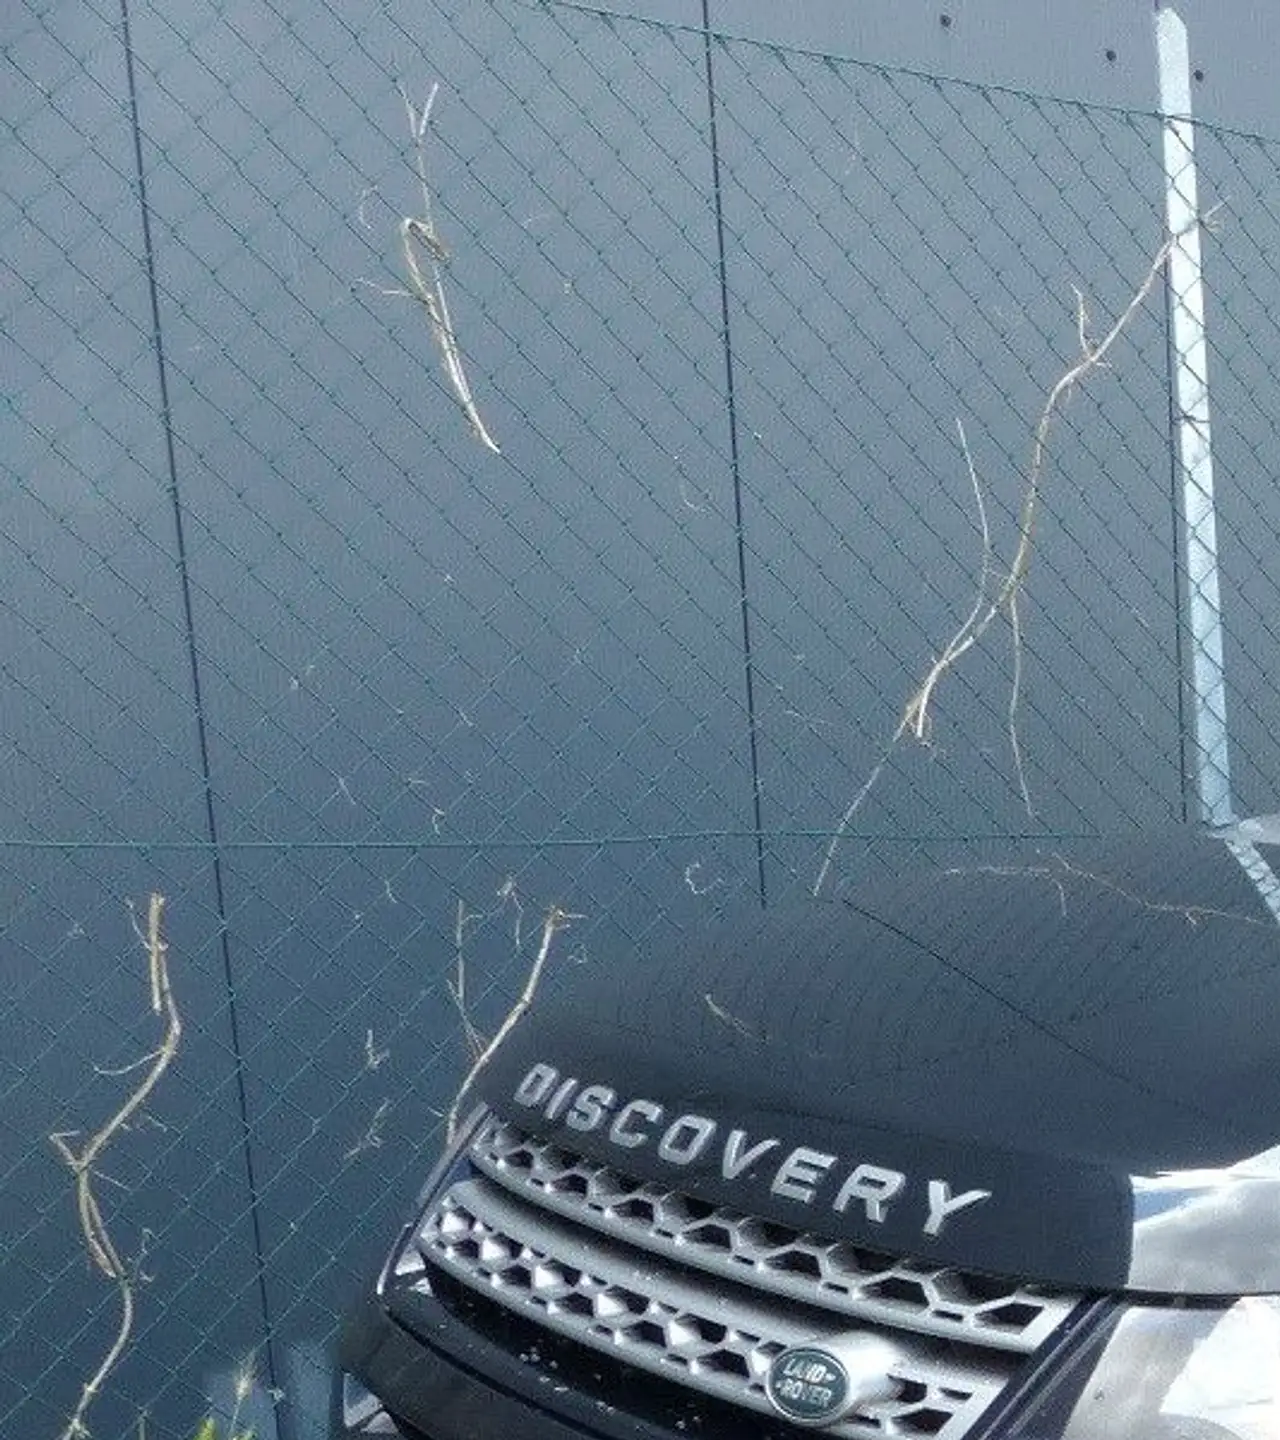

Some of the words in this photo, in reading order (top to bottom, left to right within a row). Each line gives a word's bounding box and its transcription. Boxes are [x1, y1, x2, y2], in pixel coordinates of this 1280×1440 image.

[513, 1062, 993, 1238] DISCOVERY
[783, 1357, 827, 1383] LAND
[780, 1378, 833, 1408] ROVER
